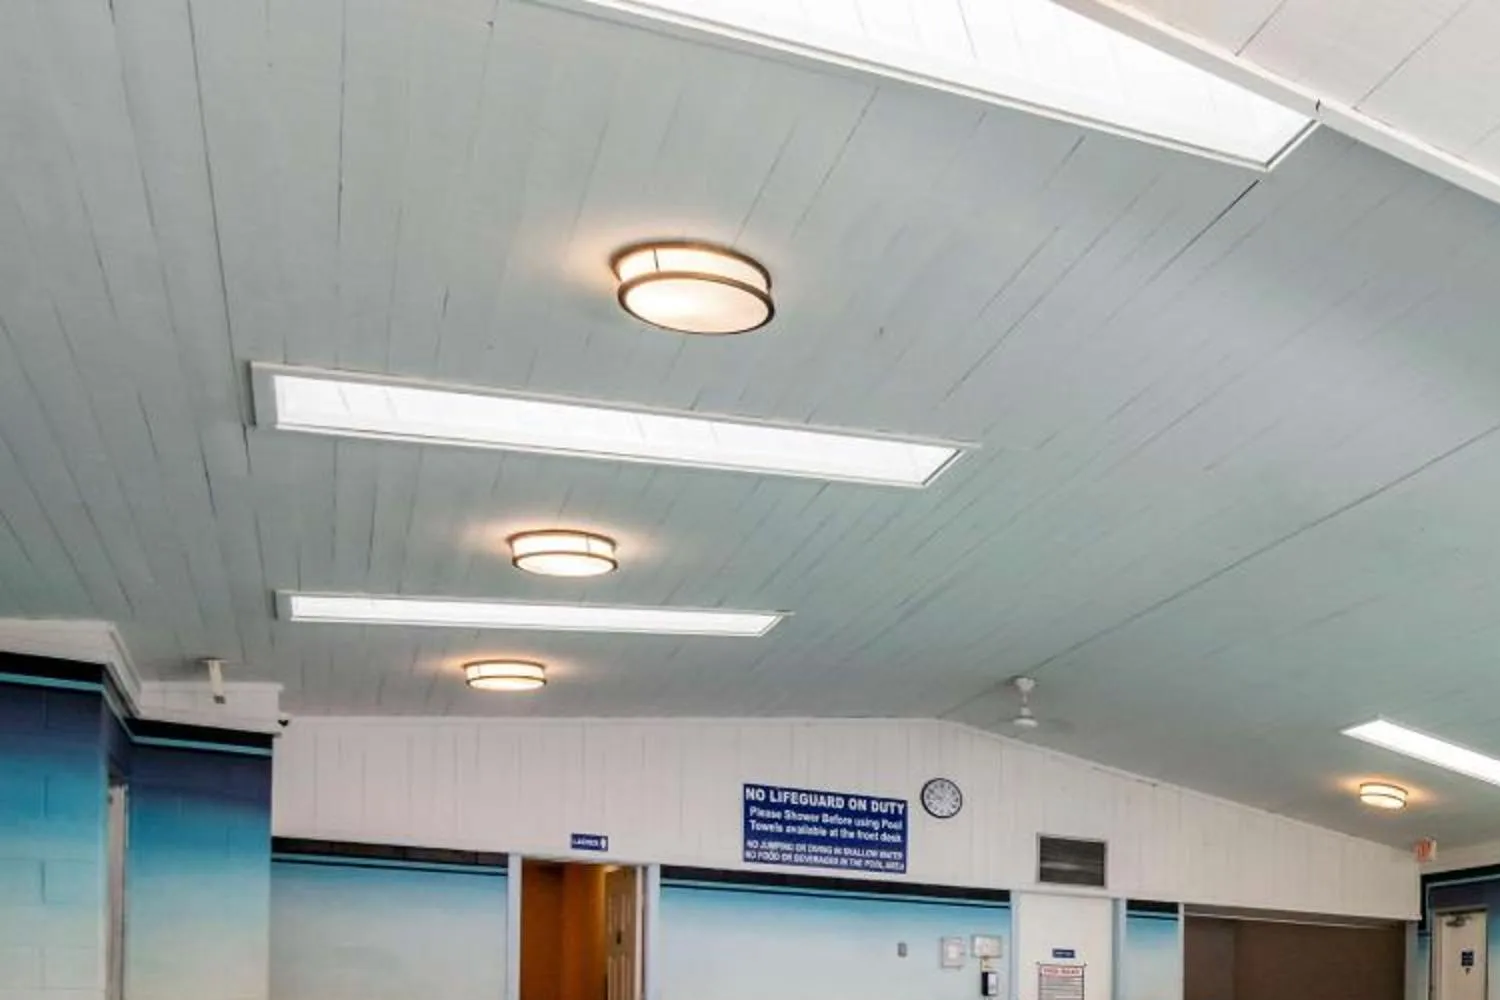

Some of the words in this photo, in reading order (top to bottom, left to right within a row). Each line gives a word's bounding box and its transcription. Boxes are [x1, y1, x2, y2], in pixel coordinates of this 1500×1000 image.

[745, 787, 765, 801] NO
[769, 789, 845, 809] LIFEGUARD
[848, 798, 867, 811] ON
[871, 800, 905, 814] DUTY
[749, 806, 782, 819] Please
[783, 810, 820, 822] Shower
[822, 813, 852, 825] Before
[854, 817, 880, 830] using
[881, 818, 903, 830] Pool
[749, 819, 784, 832] Towels
[785, 824, 827, 837] available
[829, 827, 839, 838] at
[840, 827, 855, 839] the
[857, 829, 879, 841] front
